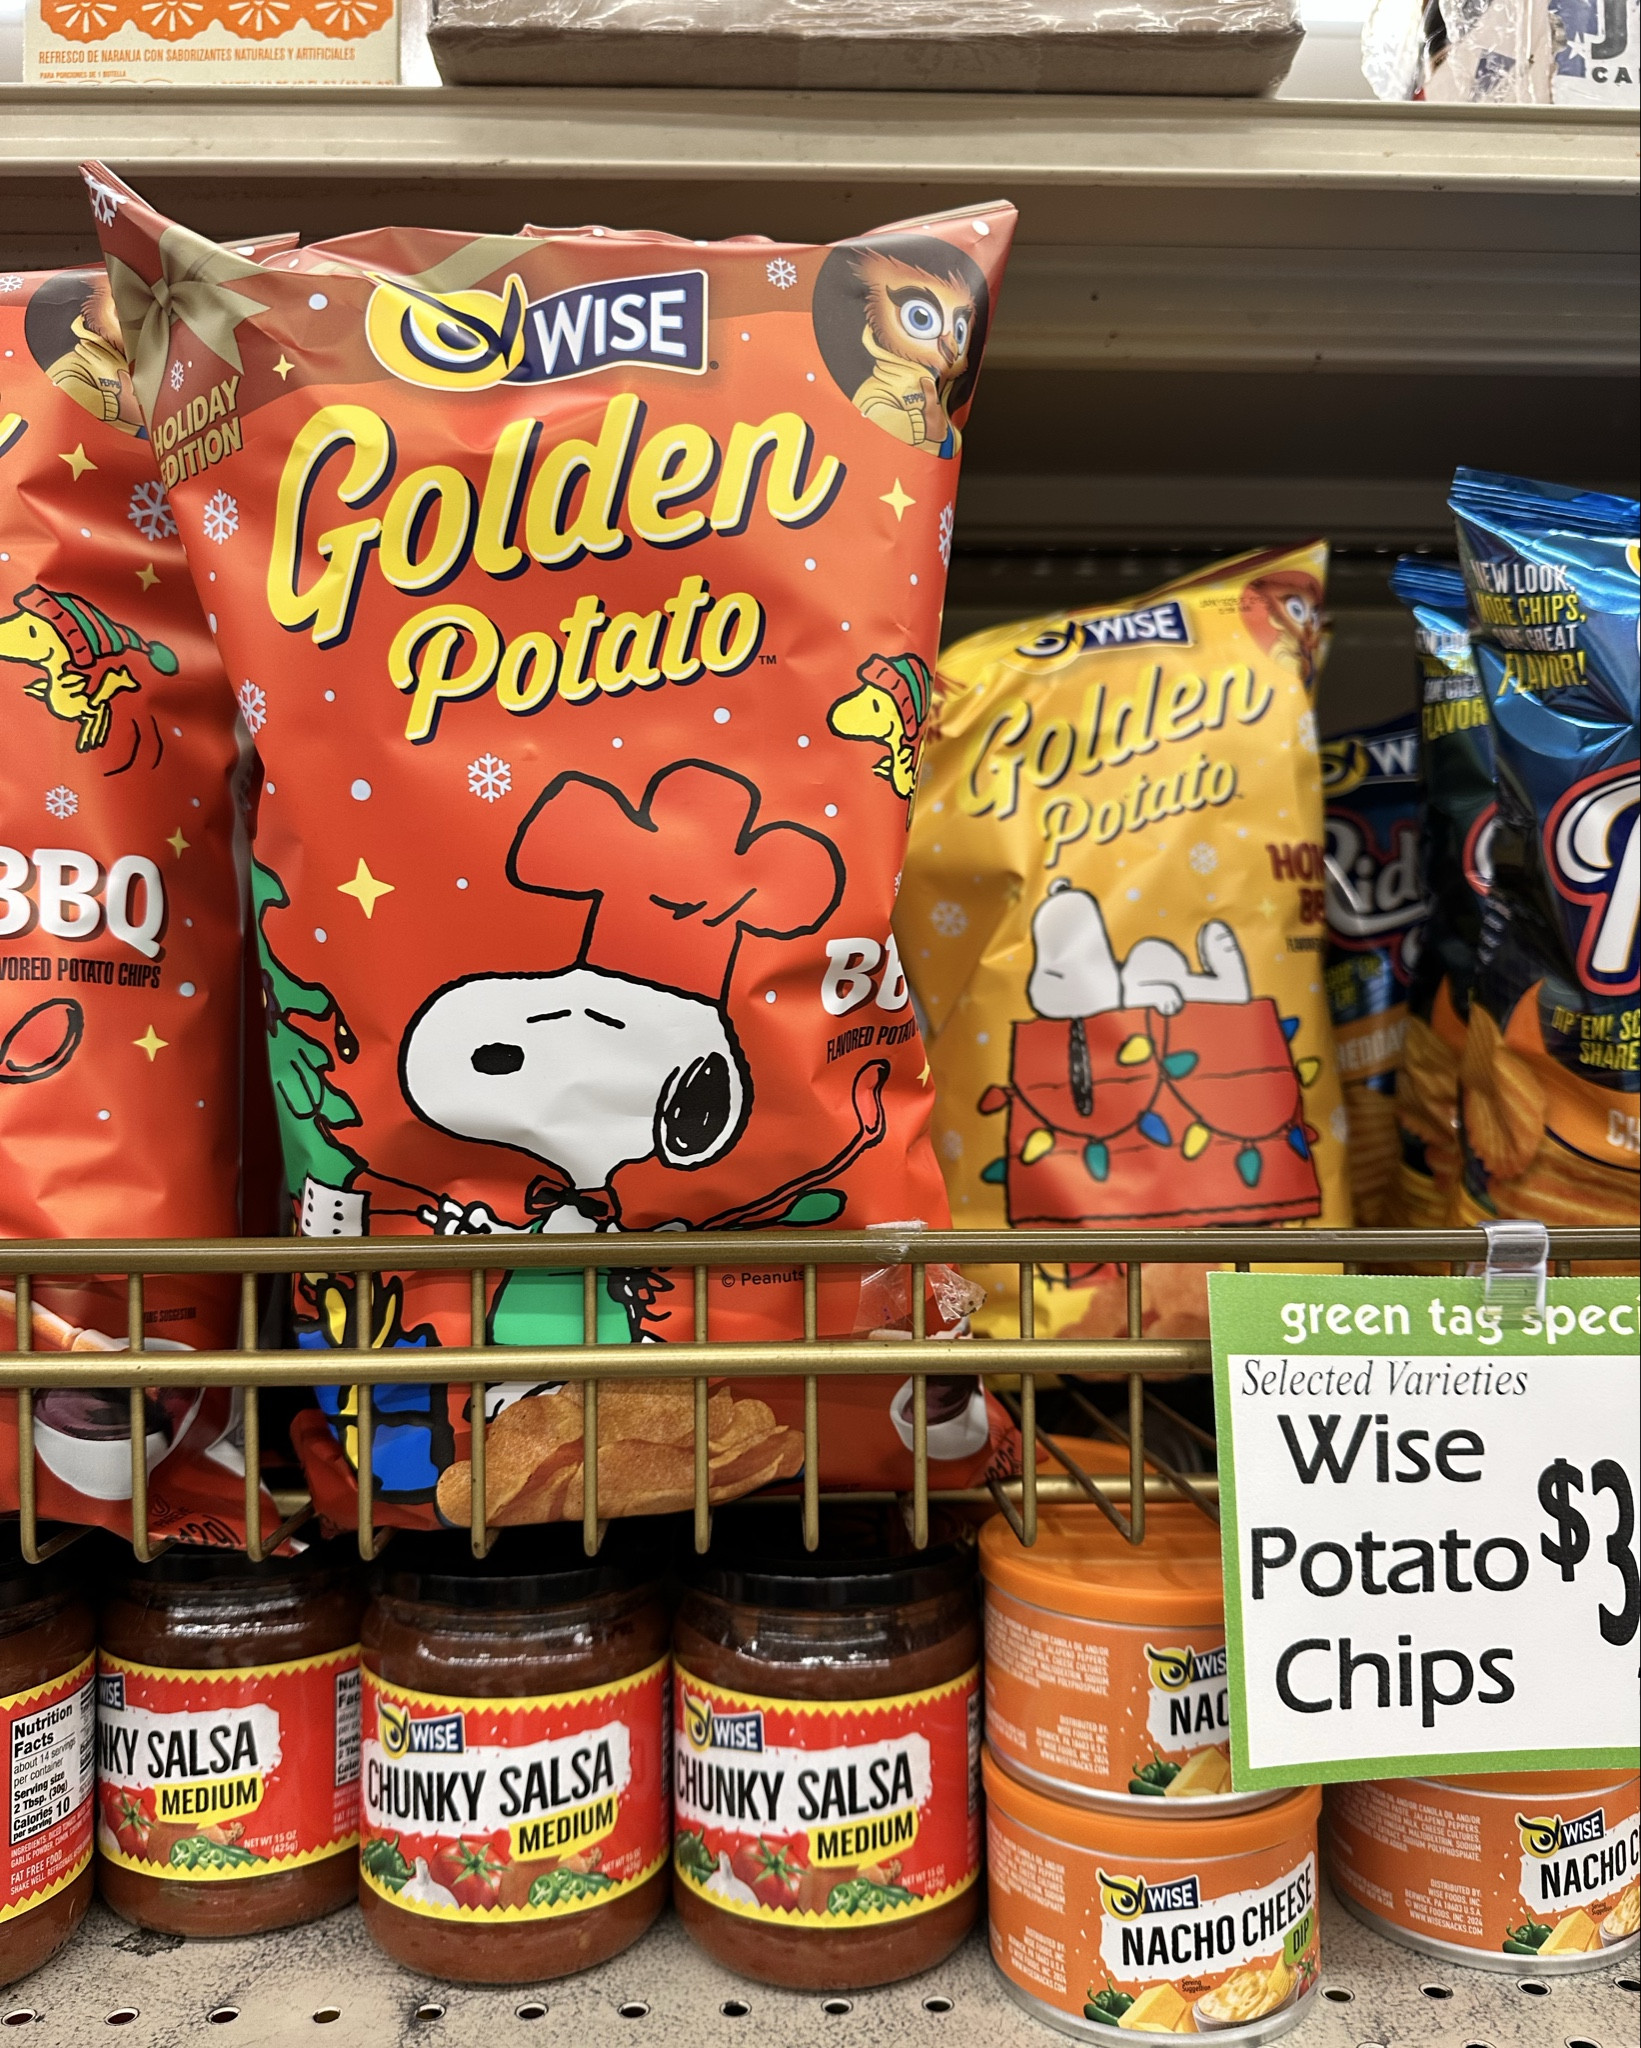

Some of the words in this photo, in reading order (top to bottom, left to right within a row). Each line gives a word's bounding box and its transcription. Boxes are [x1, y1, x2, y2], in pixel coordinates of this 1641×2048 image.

[39, 50, 84, 64] REFRESCO
[87, 50, 99, 63] DE
[102, 49, 141, 62] NARANJA
[144, 49, 164, 62] CON
[166, 47, 232, 62] SABORIZANTES
[234, 47, 286, 61] NATURALES
[288, 47, 294, 60] Y
[295, 47, 355, 61] ARTIFICIALES
[1592, 66, 1639, 84] CA
[533, 288, 687, 374] WISE
[152, 375, 240, 461] HOLIDAY
[267, 393, 846, 649] Golden
[1513, 562, 1578, 594] LOOK,
[1085, 603, 1182, 646] WISE
[1518, 594, 1587, 626] CHIPS,
[1525, 623, 1579, 651] GREAT
[388, 575, 766, 745] Potato
[1497, 650, 1590, 696] FLAVOR!
[956, 663, 1273, 822] Golden
[1036, 751, 1237, 870] Potato
[57, 957, 113, 985] POTATO
[118, 962, 161, 989] CHIPS
[826, 1025, 875, 1064] FLAVORED
[1579, 1040, 1640, 1070] SHARE
[741, 1269, 804, 1287] Peanuts
[1280, 1301, 1410, 1344] green
[1429, 1298, 1504, 1345] tag
[1521, 1294, 1640, 1345] spec
[1241, 1359, 1375, 1396] Selected
[1388, 1360, 1529, 1396] Varieties
[1277, 1413, 1485, 1484] Wise
[1251, 1526, 1530, 1600] Potato
[1195, 1652, 1226, 1679] WIS
[1275, 1634, 1516, 1728] Chips
[14, 1704, 72, 1740] Nutrition
[411, 1721, 459, 1751] WISE
[713, 1720, 759, 1749] WISE
[13, 1757, 38, 1775] about
[40, 1752, 49, 1763] 14
[51, 1737, 76, 1758] servings
[14, 1732, 54, 1759] Facts
[148, 1720, 258, 1779] SALSA
[13, 1774, 28, 1789] per
[30, 1757, 63, 1781] container
[14, 1780, 48, 1802] Serving
[50, 1771, 65, 1786] size
[368, 1759, 486, 1822] CHUNKY
[499, 1740, 614, 1817] SALSA
[676, 1750, 784, 1821] CHUNKY
[798, 1752, 914, 1821] SALSA
[13, 1804, 20, 1814] 2
[23, 1795, 47, 1811] Tbsp.
[49, 1779, 68, 1800] (30g)
[13, 1806, 52, 1832] Calories
[56, 1796, 70, 1817] 10
[162, 1778, 257, 1815] MEDIUM
[13, 1829, 26, 1842] per
[28, 1816, 52, 1834] serving
[244, 1837, 259, 1848] NET
[260, 1834, 273, 1846] WT
[274, 1833, 284, 1843] 15
[518, 1798, 614, 1855] MEDIUM
[817, 1811, 913, 1860] MEDIUM
[1563, 1815, 1601, 1845] WISE
[10, 1853, 31, 1869] GARLIC
[11, 1869, 24, 1885] FAT
[26, 1860, 44, 1879] FREE
[46, 1849, 62, 1868] FOOD
[1540, 1839, 1627, 1900] NACHO
[1630, 1824, 1640, 1866] C
[10, 1880, 30, 1896] SHAKE
[31, 1872, 46, 1886] WELL.
[1146, 1883, 1194, 1912] WISE
[1428, 1886, 1443, 1899] WISE
[1430, 1878, 1471, 1895] DISTRIBUTED
[1121, 1914, 1236, 1967] NACHO
[1242, 1861, 1312, 1947] CHEESE
[1413, 1901, 1428, 1914] WISE
[1433, 1898, 1442, 1908] PA
[1293, 1917, 1310, 1955] DIP
